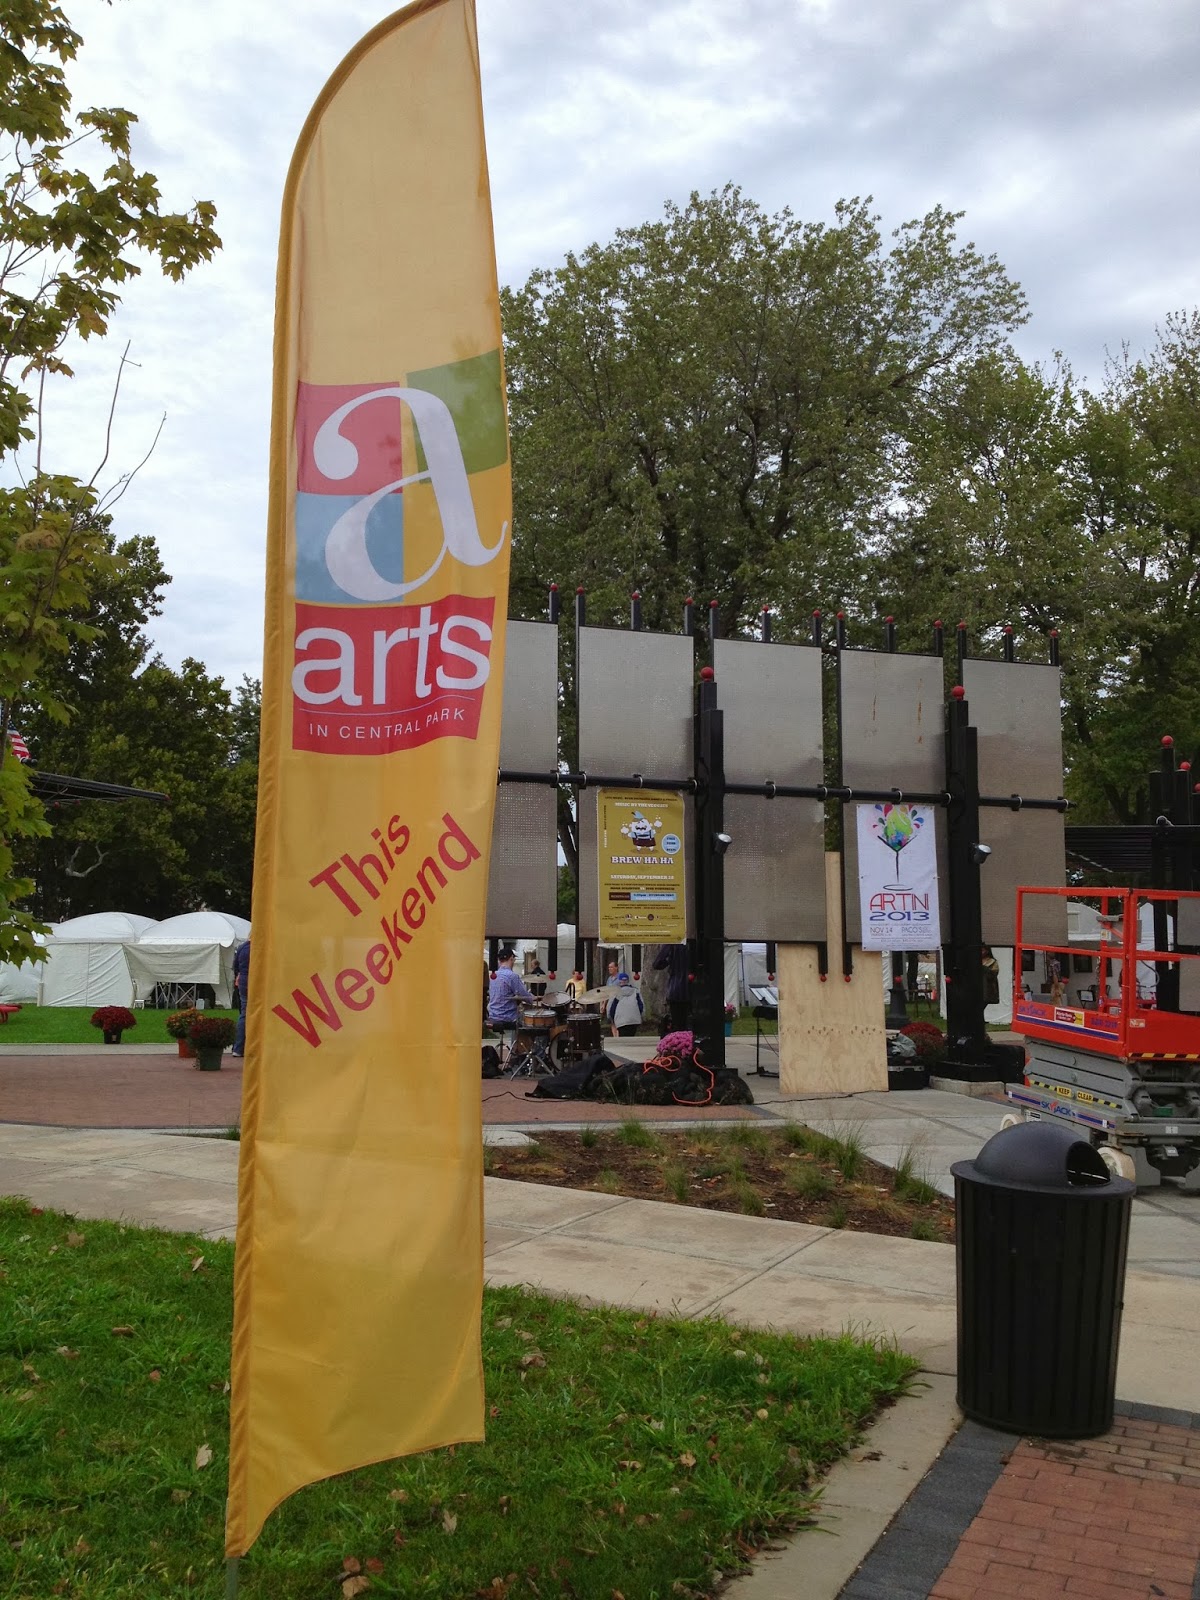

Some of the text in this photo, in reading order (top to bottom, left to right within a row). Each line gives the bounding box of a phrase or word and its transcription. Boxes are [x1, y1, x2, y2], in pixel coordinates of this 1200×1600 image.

[291, 605, 493, 707] arts
[310, 708, 465, 739] IN CENTRAL PARK
[308, 814, 410, 917] This
[611, 856, 642, 864] BREW
[869, 911, 929, 921] 2013
[271, 812, 482, 1048] Weekend
[1058, 1087, 1092, 1100] KEEP CLEAR
[1041, 1100, 1072, 1116] SKYJACK
